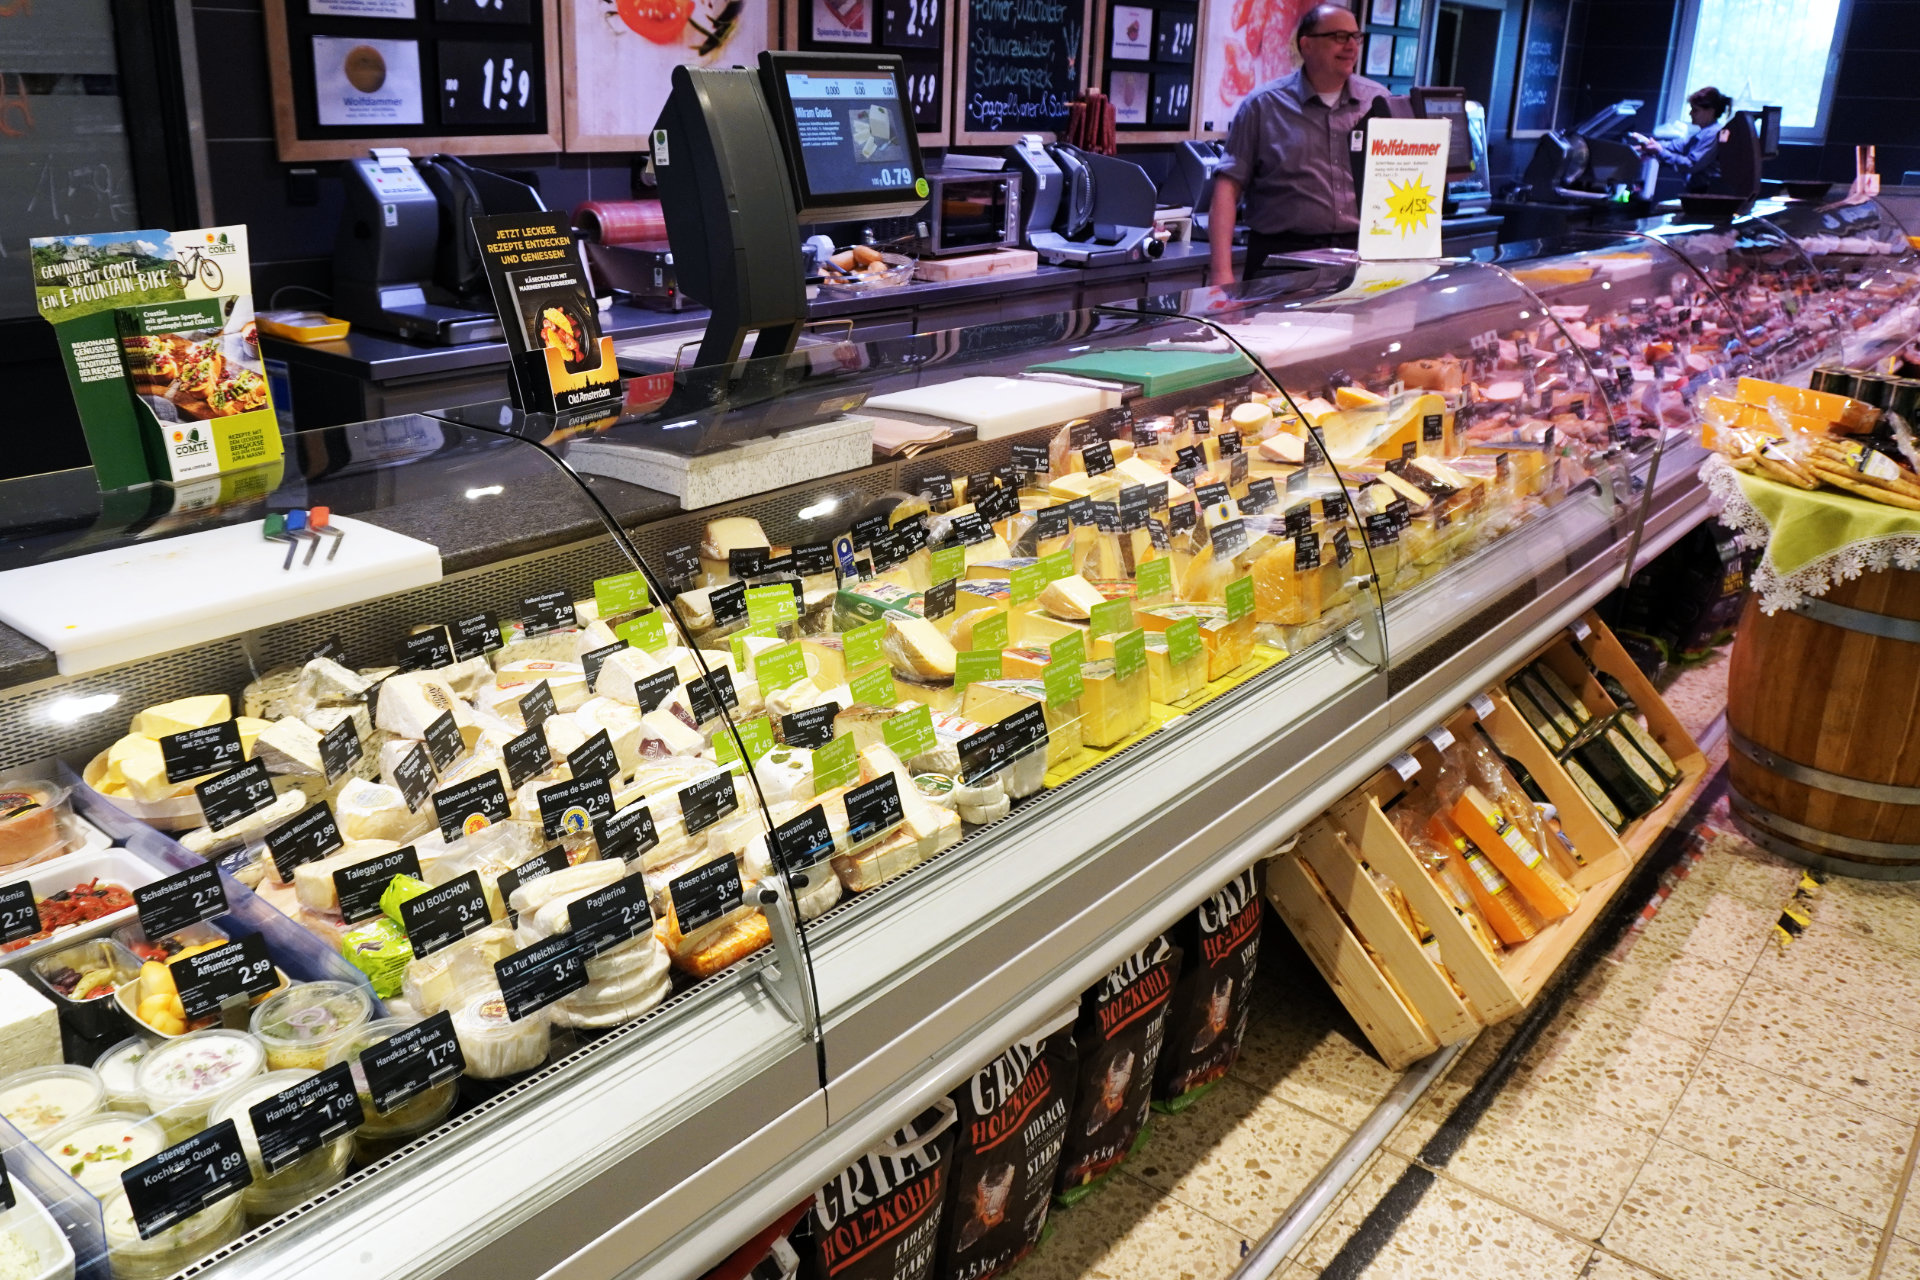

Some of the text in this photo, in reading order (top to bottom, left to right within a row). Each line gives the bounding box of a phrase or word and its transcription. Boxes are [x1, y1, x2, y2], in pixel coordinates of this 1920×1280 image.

[483, 58, 530, 110] 1.59
[826, 86, 894, 96] 0.000 0.00 0.00
[816, 107, 833, 118] Gouda
[1371, 139, 1441, 156] Wolfdammer
[882, 168, 912, 186] 0.79
[496, 226, 557, 240] JETZT LECKERE
[488, 236, 571, 253] REZEPTE ENTDECKEN
[41, 258, 91, 279] GEWINNEN
[501, 250, 566, 265] UND GENIESSEN!
[67, 258, 139, 288] SIE MIT COMTÉ
[42, 294, 59, 310] EIN
[145, 317, 156, 325] mit
[74, 344, 104, 357] GENUSS
[79, 364, 123, 377] DER REGION
[554, 606, 573, 620] 2.99
[482, 628, 500, 643] 2.99
[431, 644, 449, 660] 2.99
[213, 742, 240, 760] 2.69
[344, 736, 359, 756] 2.99
[532, 745, 548, 764] 3.49
[754, 738, 773, 755] 4.49
[989, 744, 1006, 762] 2.49
[599, 750, 614, 770] 3.49
[204, 764, 258, 796] ROCHEBARON
[245, 778, 270, 801] 3.79
[477, 778, 497, 790] Savoie
[542, 777, 603, 804] Tomme de Savoie
[482, 792, 505, 814] 3.49
[586, 792, 611, 813] 2.99
[714, 786, 734, 807] 2.99
[882, 795, 899, 815] 3.99
[314, 824, 336, 848] 2.99
[605, 826, 621, 840] Black
[621, 812, 642, 830] Bomber
[634, 820, 653, 842] 3.49
[778, 817, 813, 841] Cravanzina
[809, 828, 829, 850] 3.99
[345, 854, 405, 881] Taleggio DOP
[516, 856, 548, 878] RAMBOL
[140, 870, 213, 903] Schafskäse Xenia
[679, 876, 700, 892] Rosso
[717, 878, 740, 900] 3.99
[192, 885, 221, 909] 2.79
[412, 880, 471, 916] AU BOUCHON
[586, 884, 627, 910] Paglierina
[2, 906, 34, 929] 2.79
[458, 897, 484, 922] 3.49
[620, 899, 647, 924] 2.99
[191, 942, 244, 967] Scamorzine
[502, 938, 570, 978] La Tur Weichkäse
[197, 954, 245, 978] Affumicate
[238, 959, 271, 985] 2.99
[553, 956, 581, 982] 3.49
[1098, 963, 1171, 1032] HOLZKOHLE
[390, 1027, 422, 1047] Stengers
[376, 1030, 441, 1068] Handkäs mit Musik
[426, 1040, 457, 1068] 1.79
[278, 1076, 321, 1103] Stengers
[317, 1093, 355, 1121] 1.09
[971, 1057, 1052, 1146] HOLZKOHLE
[1024, 1098, 1067, 1146] EINFACH
[157, 1138, 200, 1164] Stengers
[144, 1142, 222, 1188] Kochkäse Quark
[204, 1152, 242, 1184] 1.89
[821, 1166, 943, 1268] HOLZKOHLE
